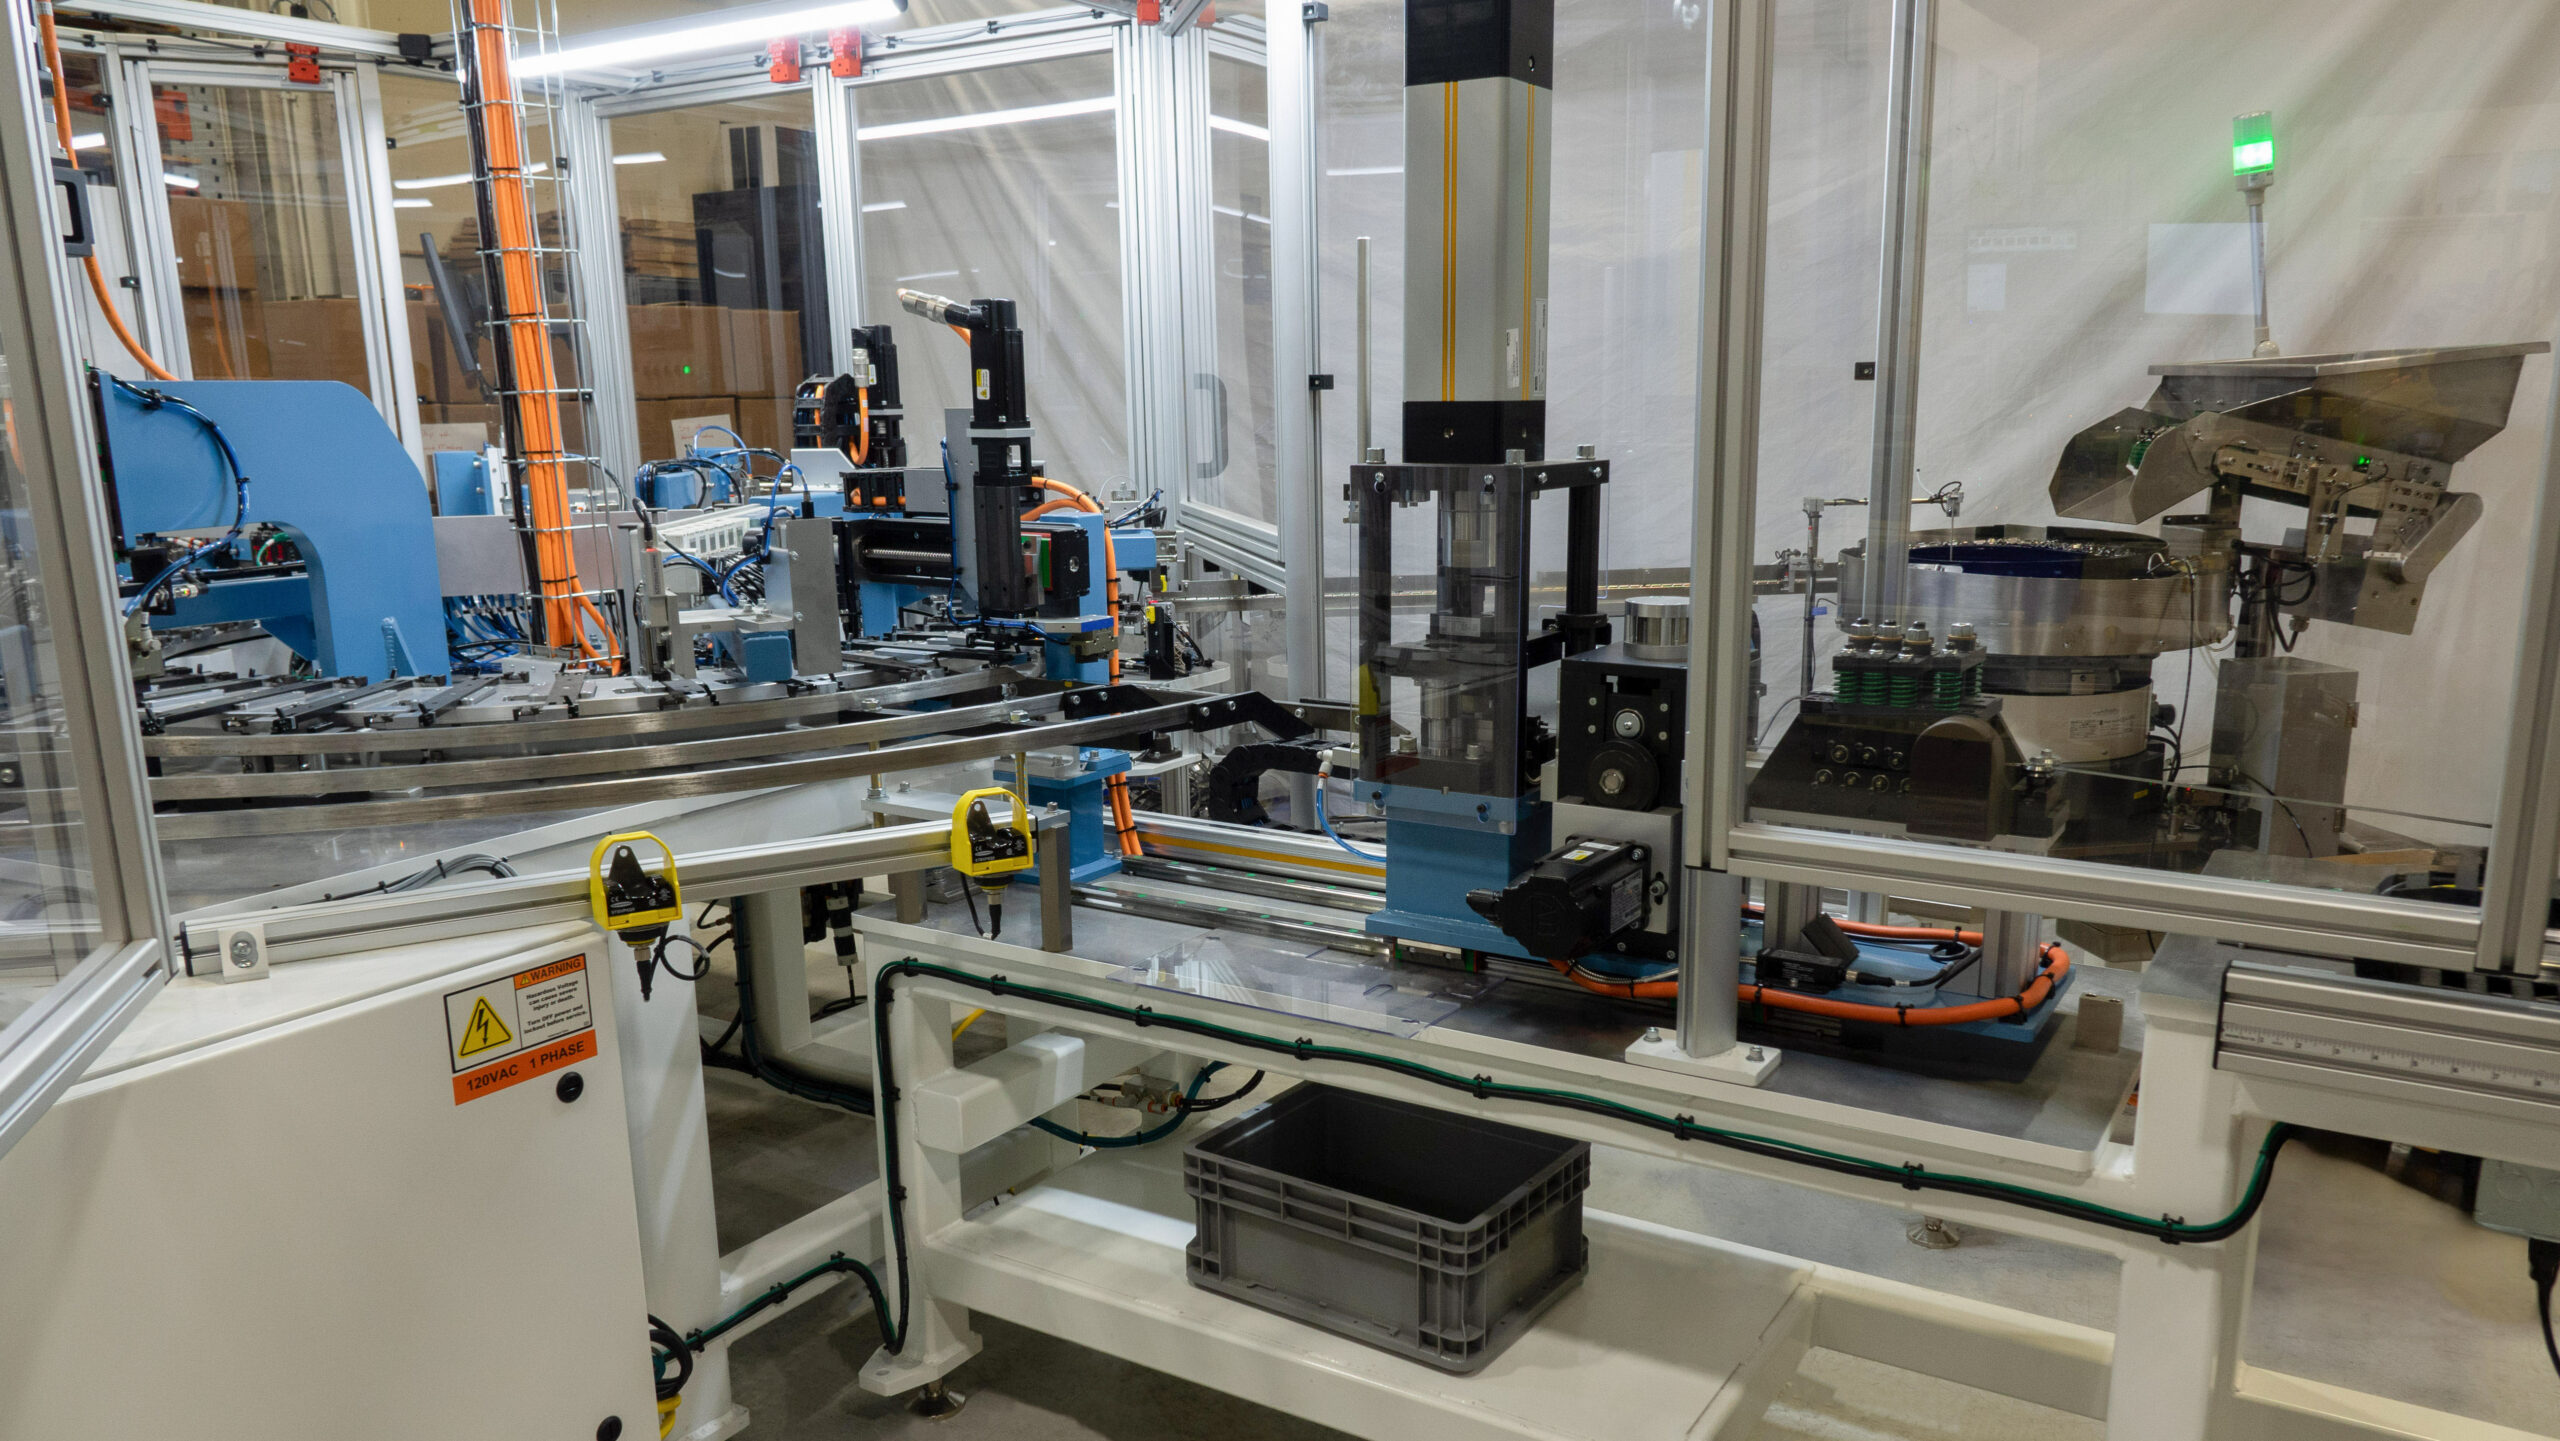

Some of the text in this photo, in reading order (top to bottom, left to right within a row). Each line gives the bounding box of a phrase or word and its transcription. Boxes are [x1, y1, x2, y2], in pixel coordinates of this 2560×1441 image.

[530, 958, 581, 981] WARNING
[526, 980, 579, 1000] Hazardous Voltage
[540, 993, 558, 1002] cause
[558, 987, 578, 996] severe
[527, 1004, 583, 1026] Turn OFF power and
[533, 1002, 549, 1011] injury
[524, 1024, 546, 1034] lockout
[546, 1017, 565, 1027] before
[466, 1040, 585, 1091] 120VAC 1 PHASE
